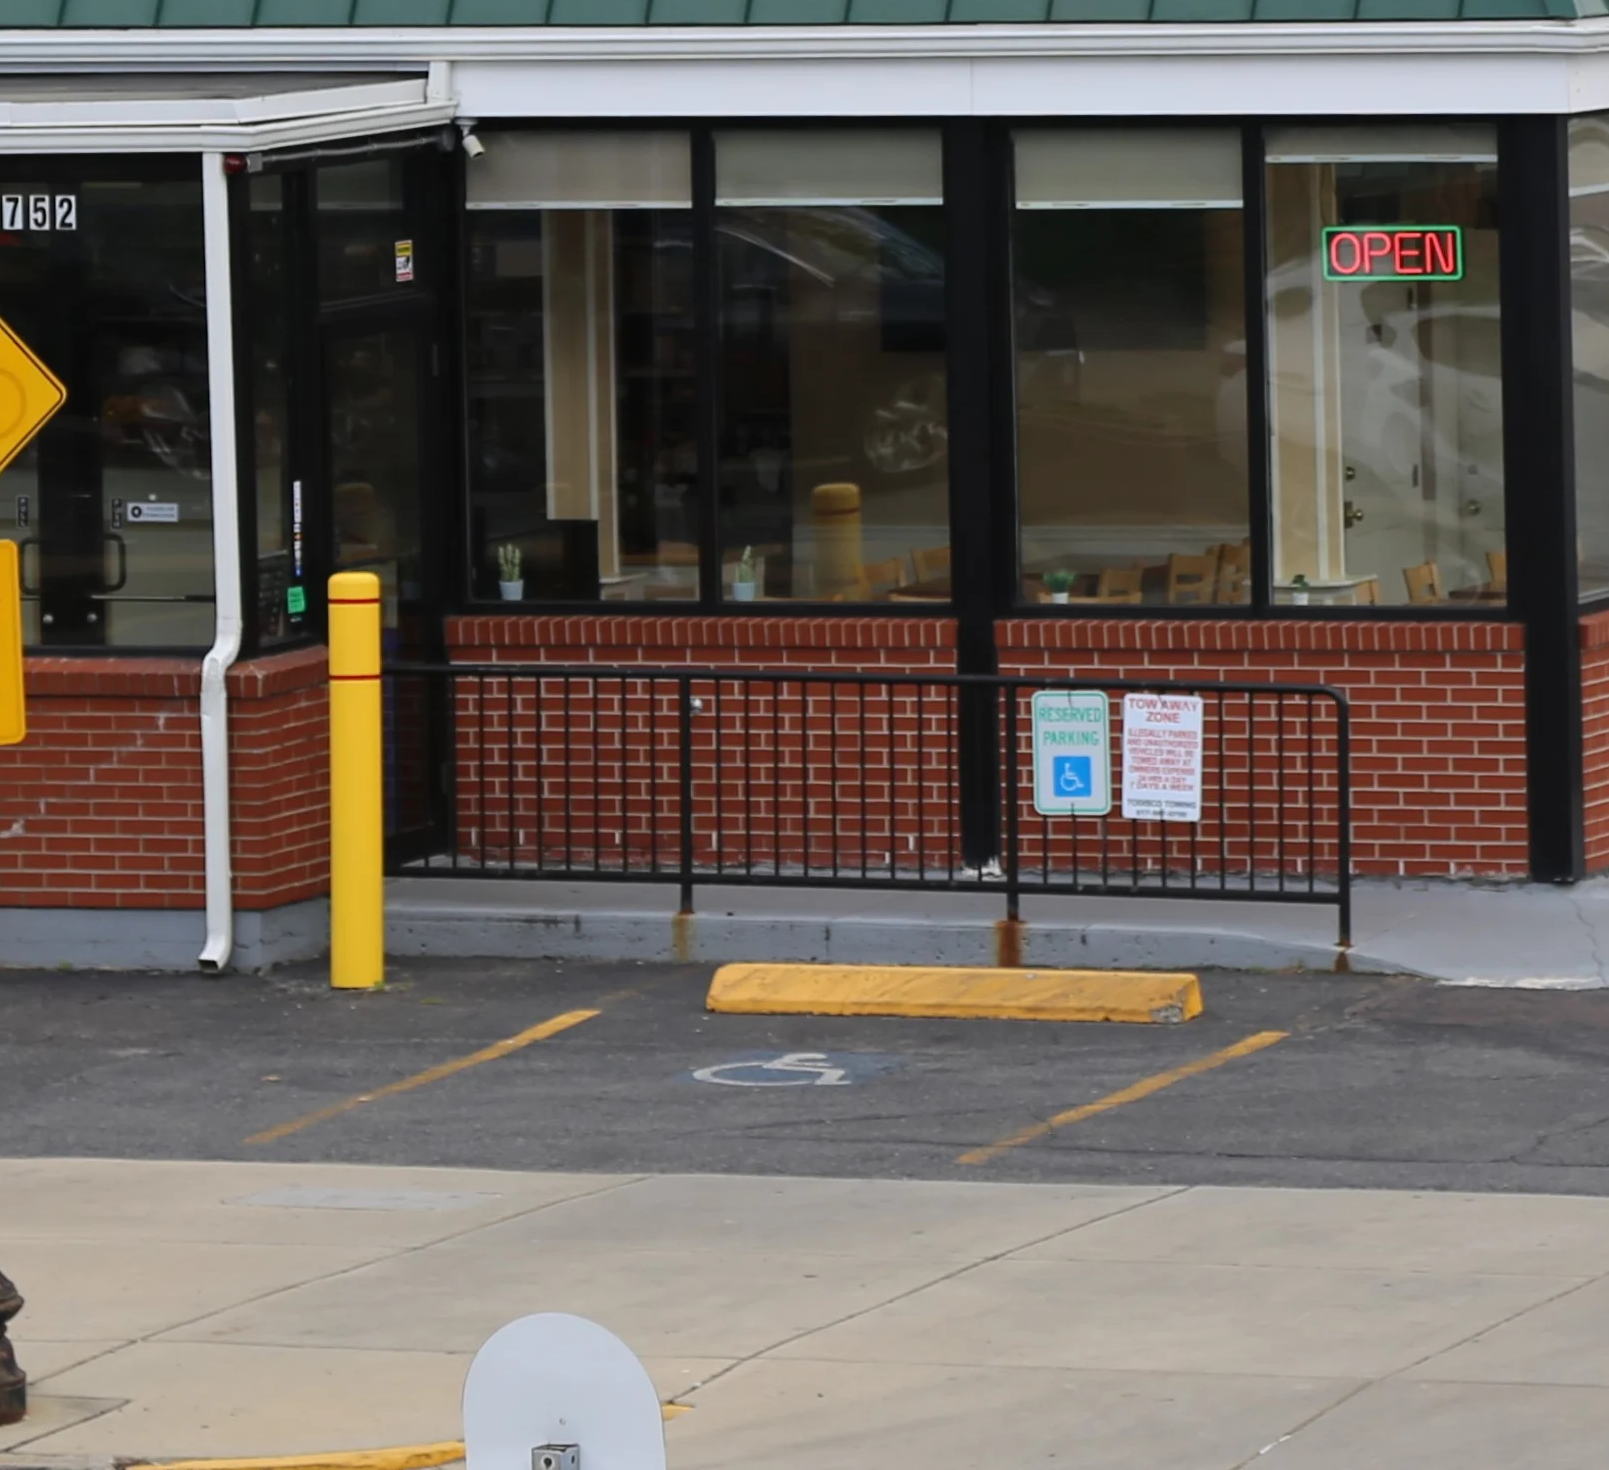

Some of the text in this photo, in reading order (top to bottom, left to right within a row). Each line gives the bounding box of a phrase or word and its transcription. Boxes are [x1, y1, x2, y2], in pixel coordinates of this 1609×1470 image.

[4, 196, 75, 229] 752
[1329, 231, 1455, 275] OPEN
[1129, 699, 1198, 712] TOW AWAY
[1039, 707, 1101, 722] RESERVED
[1146, 712, 1180, 723] ZONE
[1043, 731, 1099, 745] PARKING
